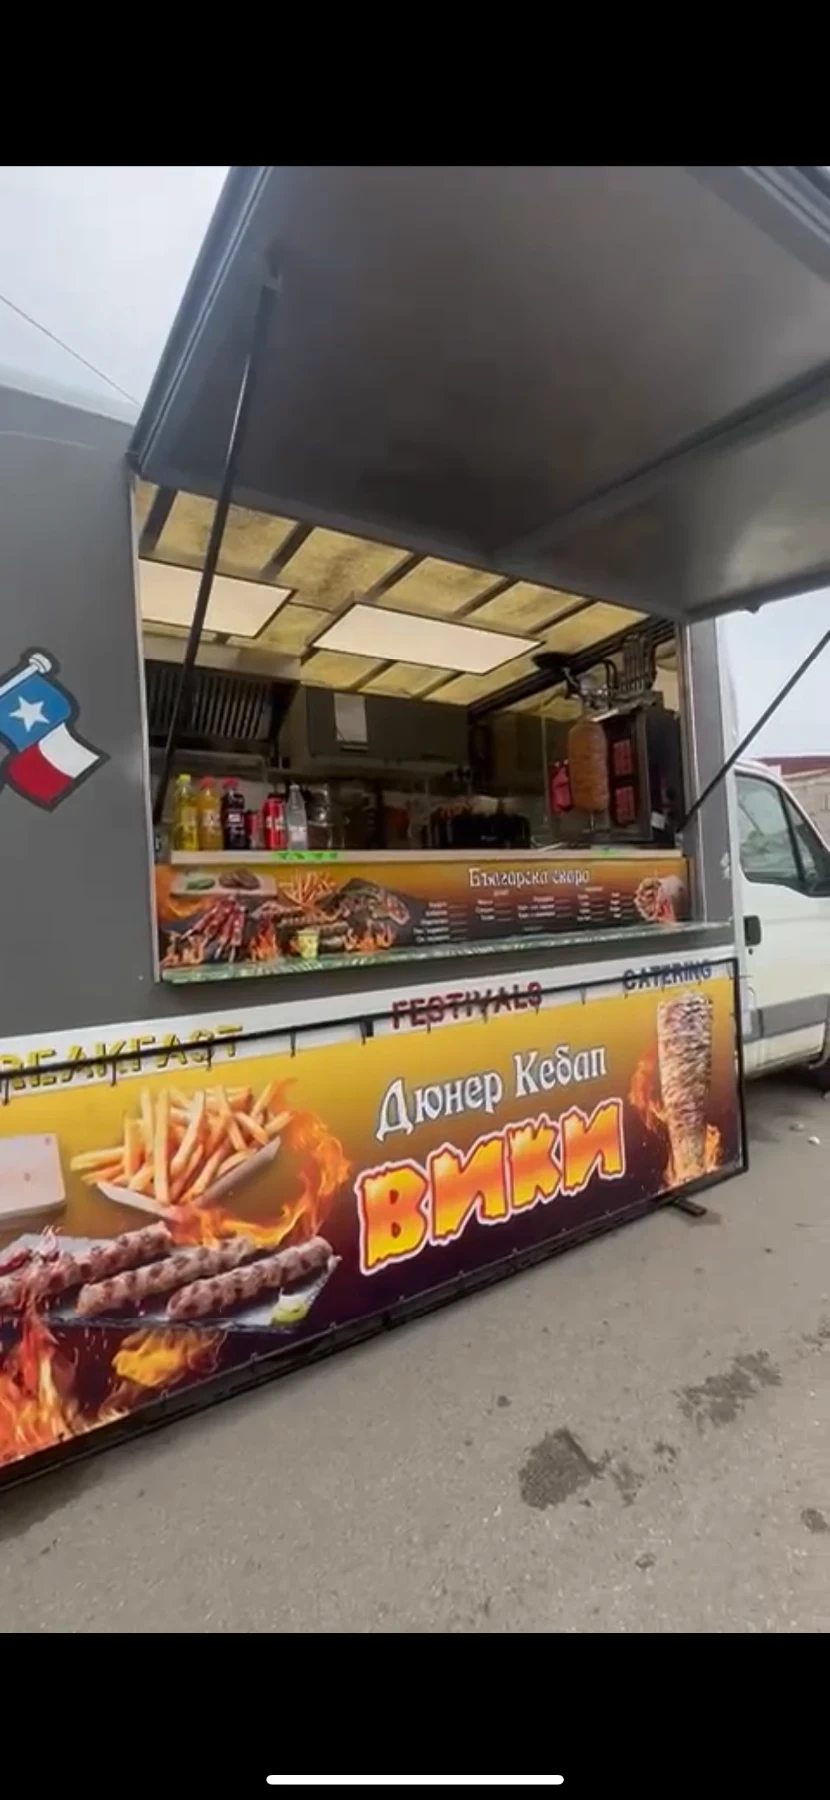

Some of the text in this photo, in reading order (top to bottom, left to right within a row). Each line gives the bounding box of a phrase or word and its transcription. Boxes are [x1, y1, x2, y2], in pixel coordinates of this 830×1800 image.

[392, 981, 543, 1030] FESTIVALS
[622, 960, 713, 991] CATERING
[376, 1044, 608, 1142] Дюнер Кебап
[354, 1098, 626, 1276] ВИКИ
